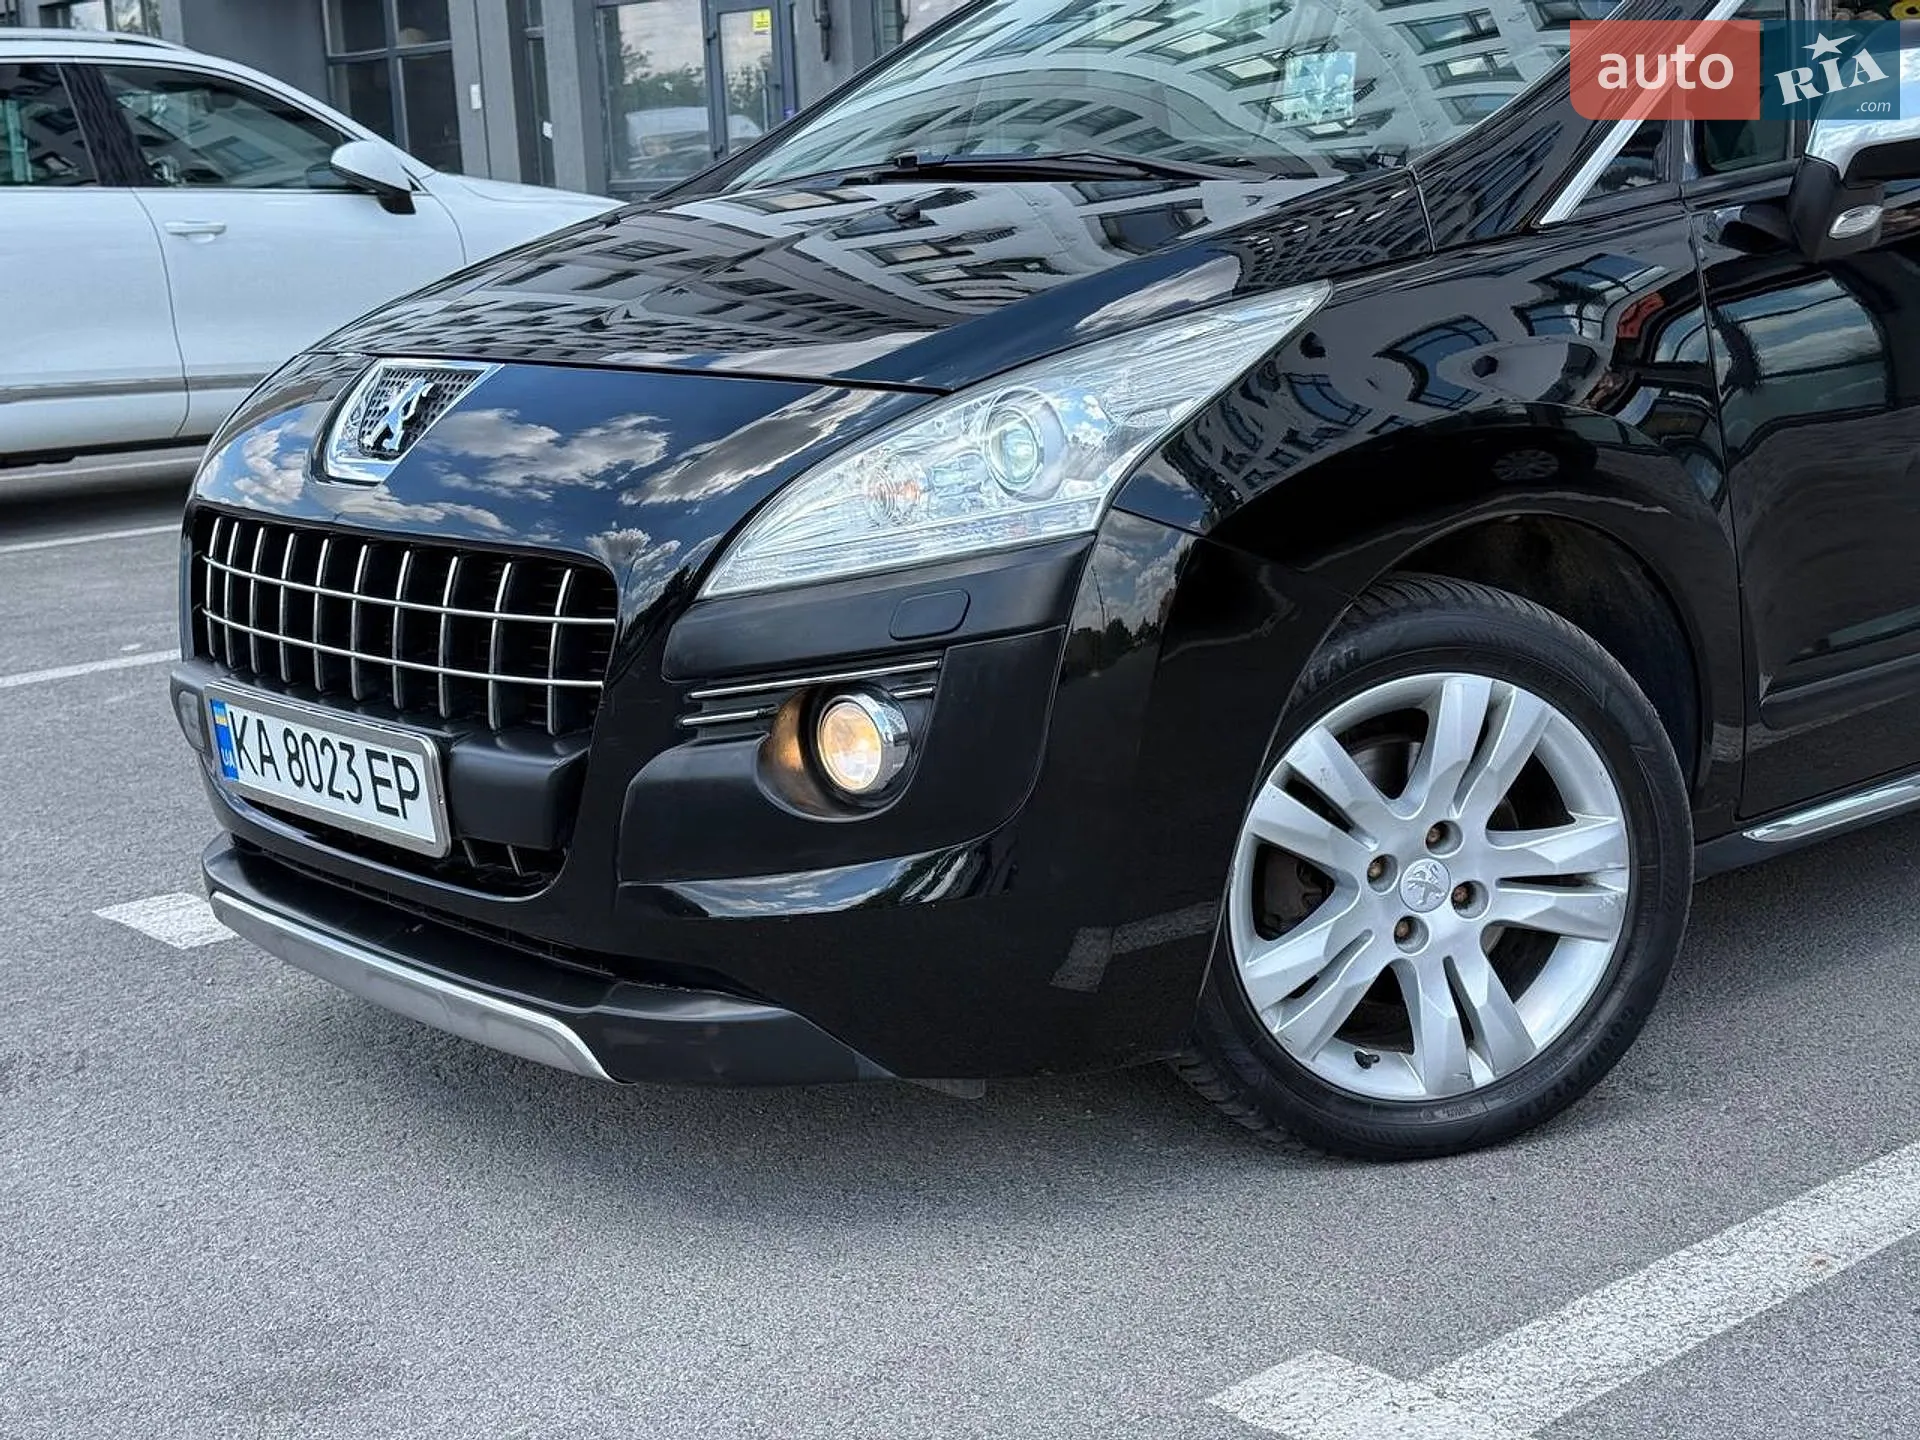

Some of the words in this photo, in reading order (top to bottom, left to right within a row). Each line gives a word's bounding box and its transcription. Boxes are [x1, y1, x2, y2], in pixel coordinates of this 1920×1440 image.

[220, 746, 237, 769] UA
[229, 711, 281, 782] KA
[283, 727, 363, 805] 8023
[365, 748, 420, 820] EP
